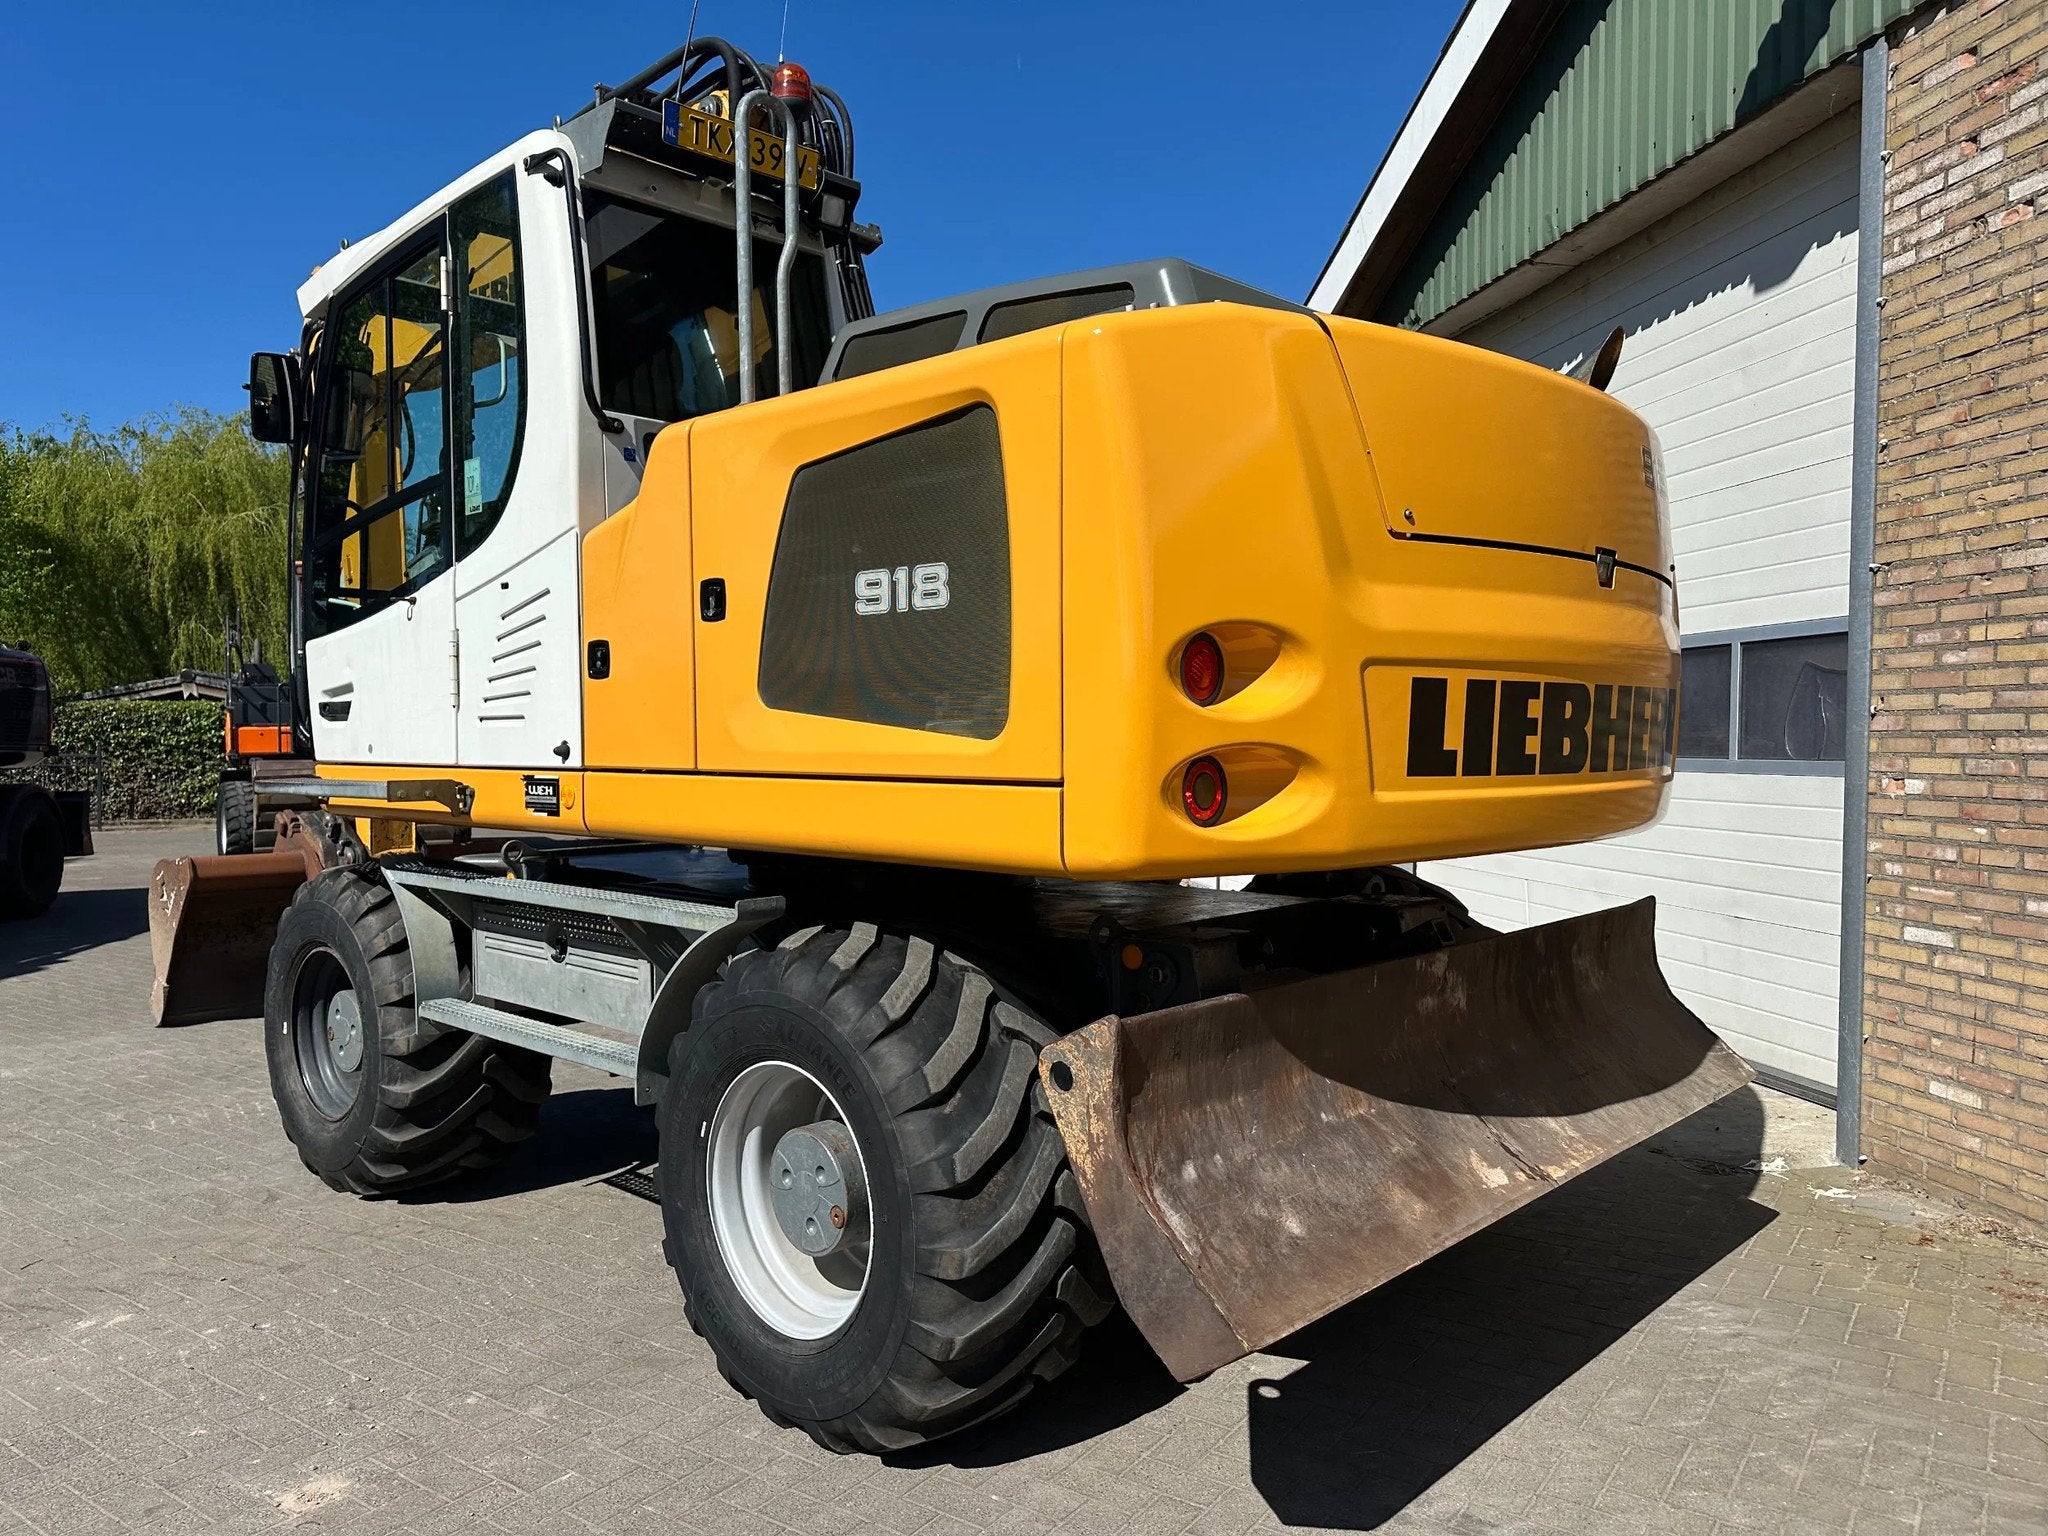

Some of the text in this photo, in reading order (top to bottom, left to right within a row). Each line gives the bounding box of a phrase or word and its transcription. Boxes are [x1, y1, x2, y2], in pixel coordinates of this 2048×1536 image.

[665, 125, 676, 138] NL
[855, 562, 949, 616] 918
[772, 1017, 857, 1100] ALLIANCE
